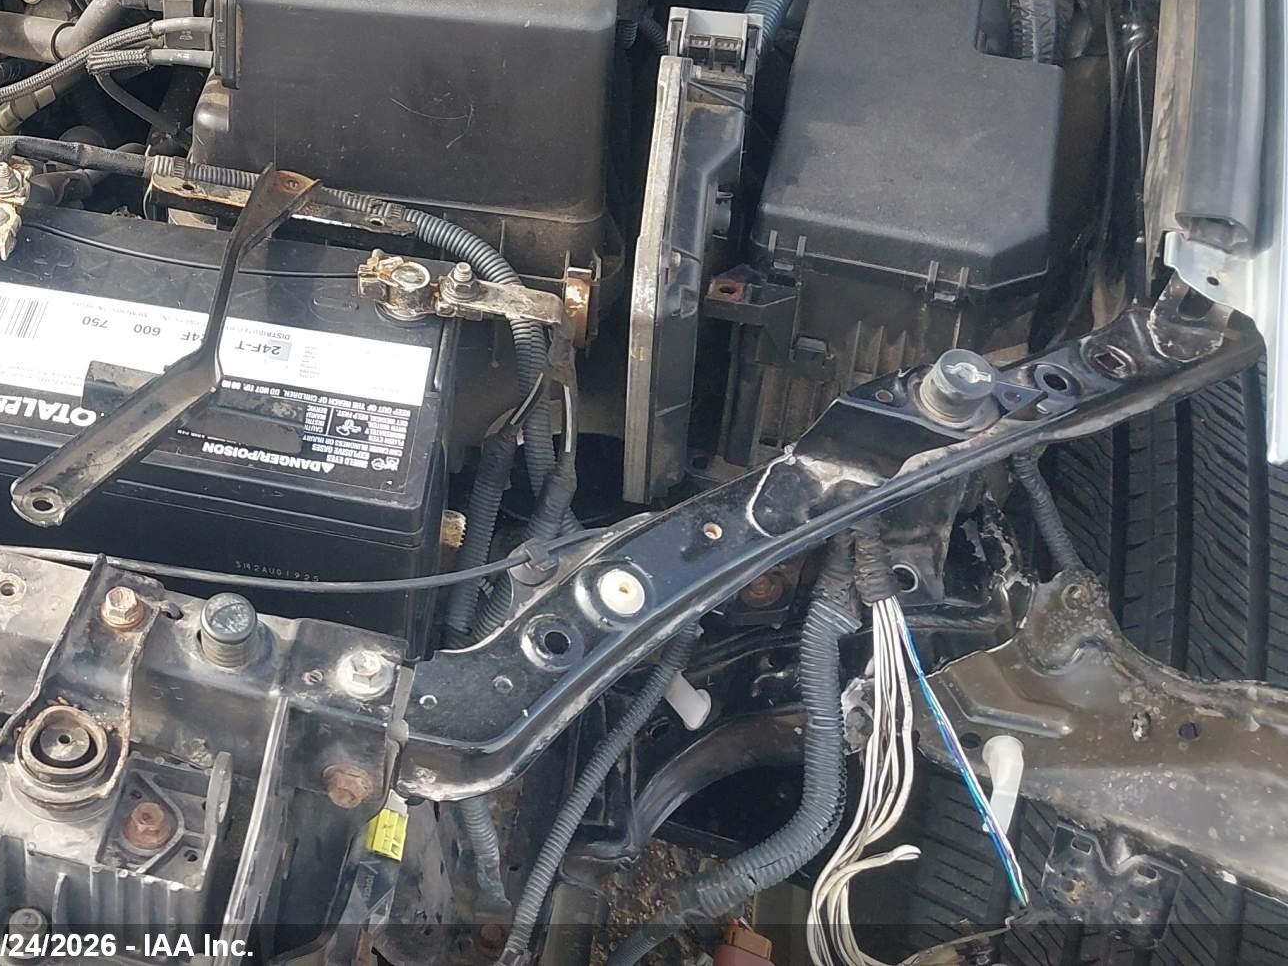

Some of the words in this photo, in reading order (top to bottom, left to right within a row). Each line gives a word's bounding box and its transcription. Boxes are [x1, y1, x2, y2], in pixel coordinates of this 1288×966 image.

[82, 316, 109, 328] 750
[133, 323, 161, 336] 600
[234, 340, 281, 356] 24F-T
[318, 396, 328, 405] OF
[366, 404, 376, 412] OF
[377, 406, 392, 414] OUT
[312, 444, 333, 454] GASES
[334, 447, 370, 460] EXPLOSIVE
[202, 441, 321, 472] DANGER/POISON
[326, 456, 344, 465] EYES
[344, 458, 368, 468] SHIELD
